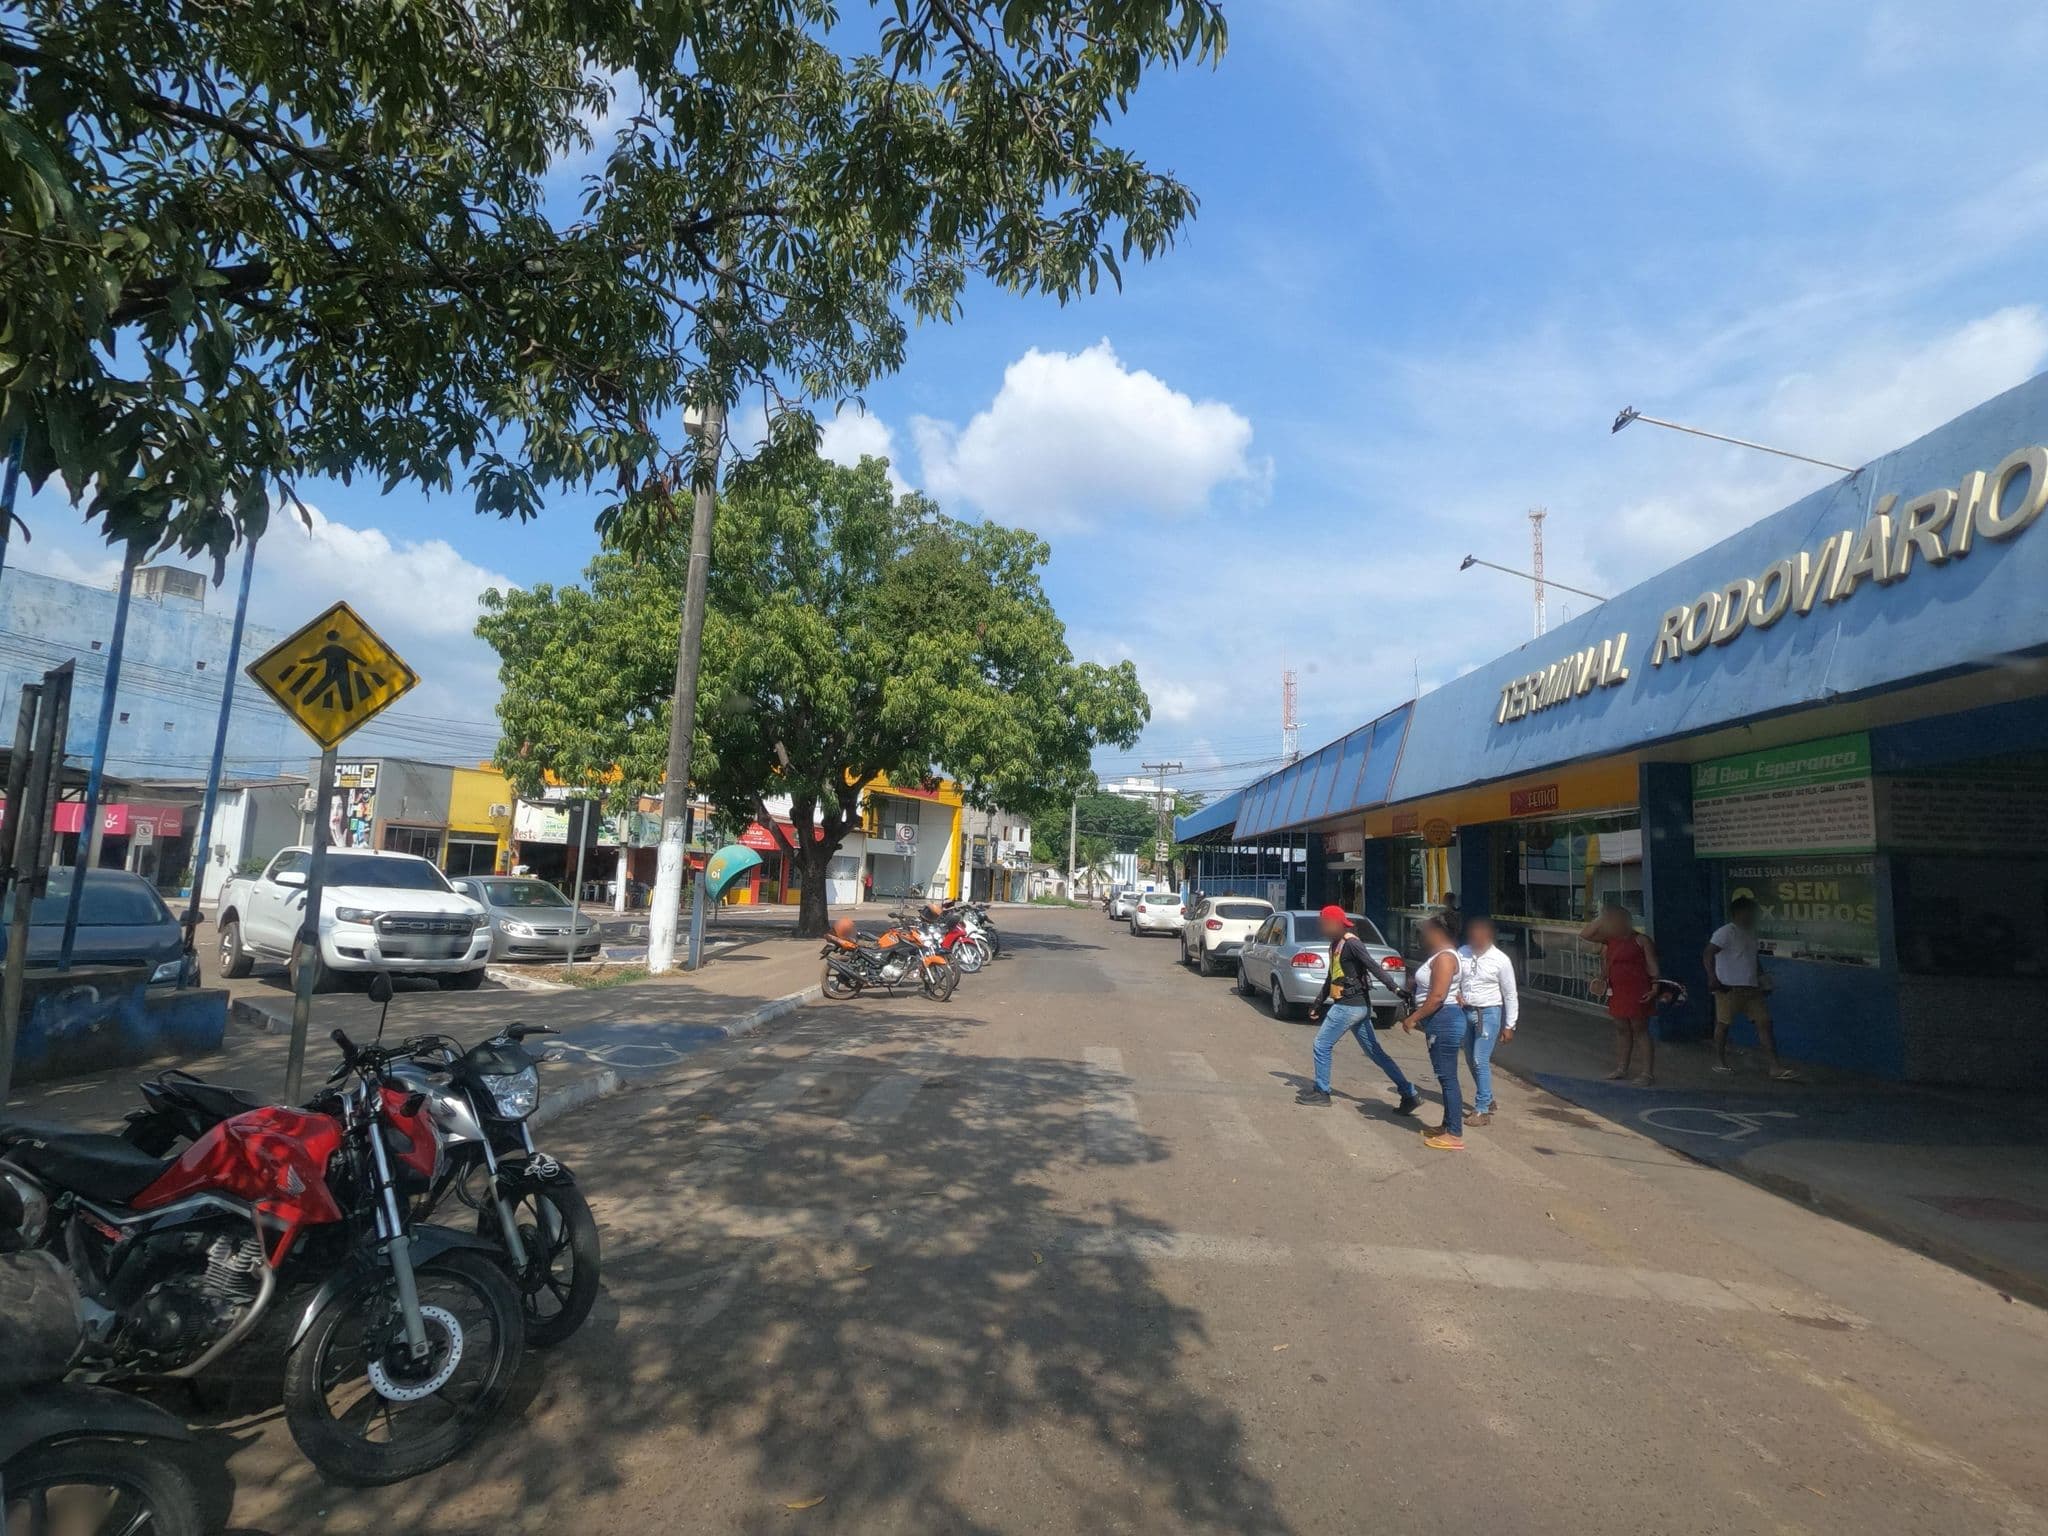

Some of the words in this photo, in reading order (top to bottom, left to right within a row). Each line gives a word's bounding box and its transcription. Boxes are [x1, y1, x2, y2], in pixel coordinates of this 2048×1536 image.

[1496, 632, 1629, 725] TERMINAL
[1651, 447, 2048, 667] RODOVIÁRIO
[711, 868, 721, 879] oi
[1777, 879, 1840, 901] SEM
[1782, 903, 1873, 924] JUROS
[382, 920, 473, 931] FORD
